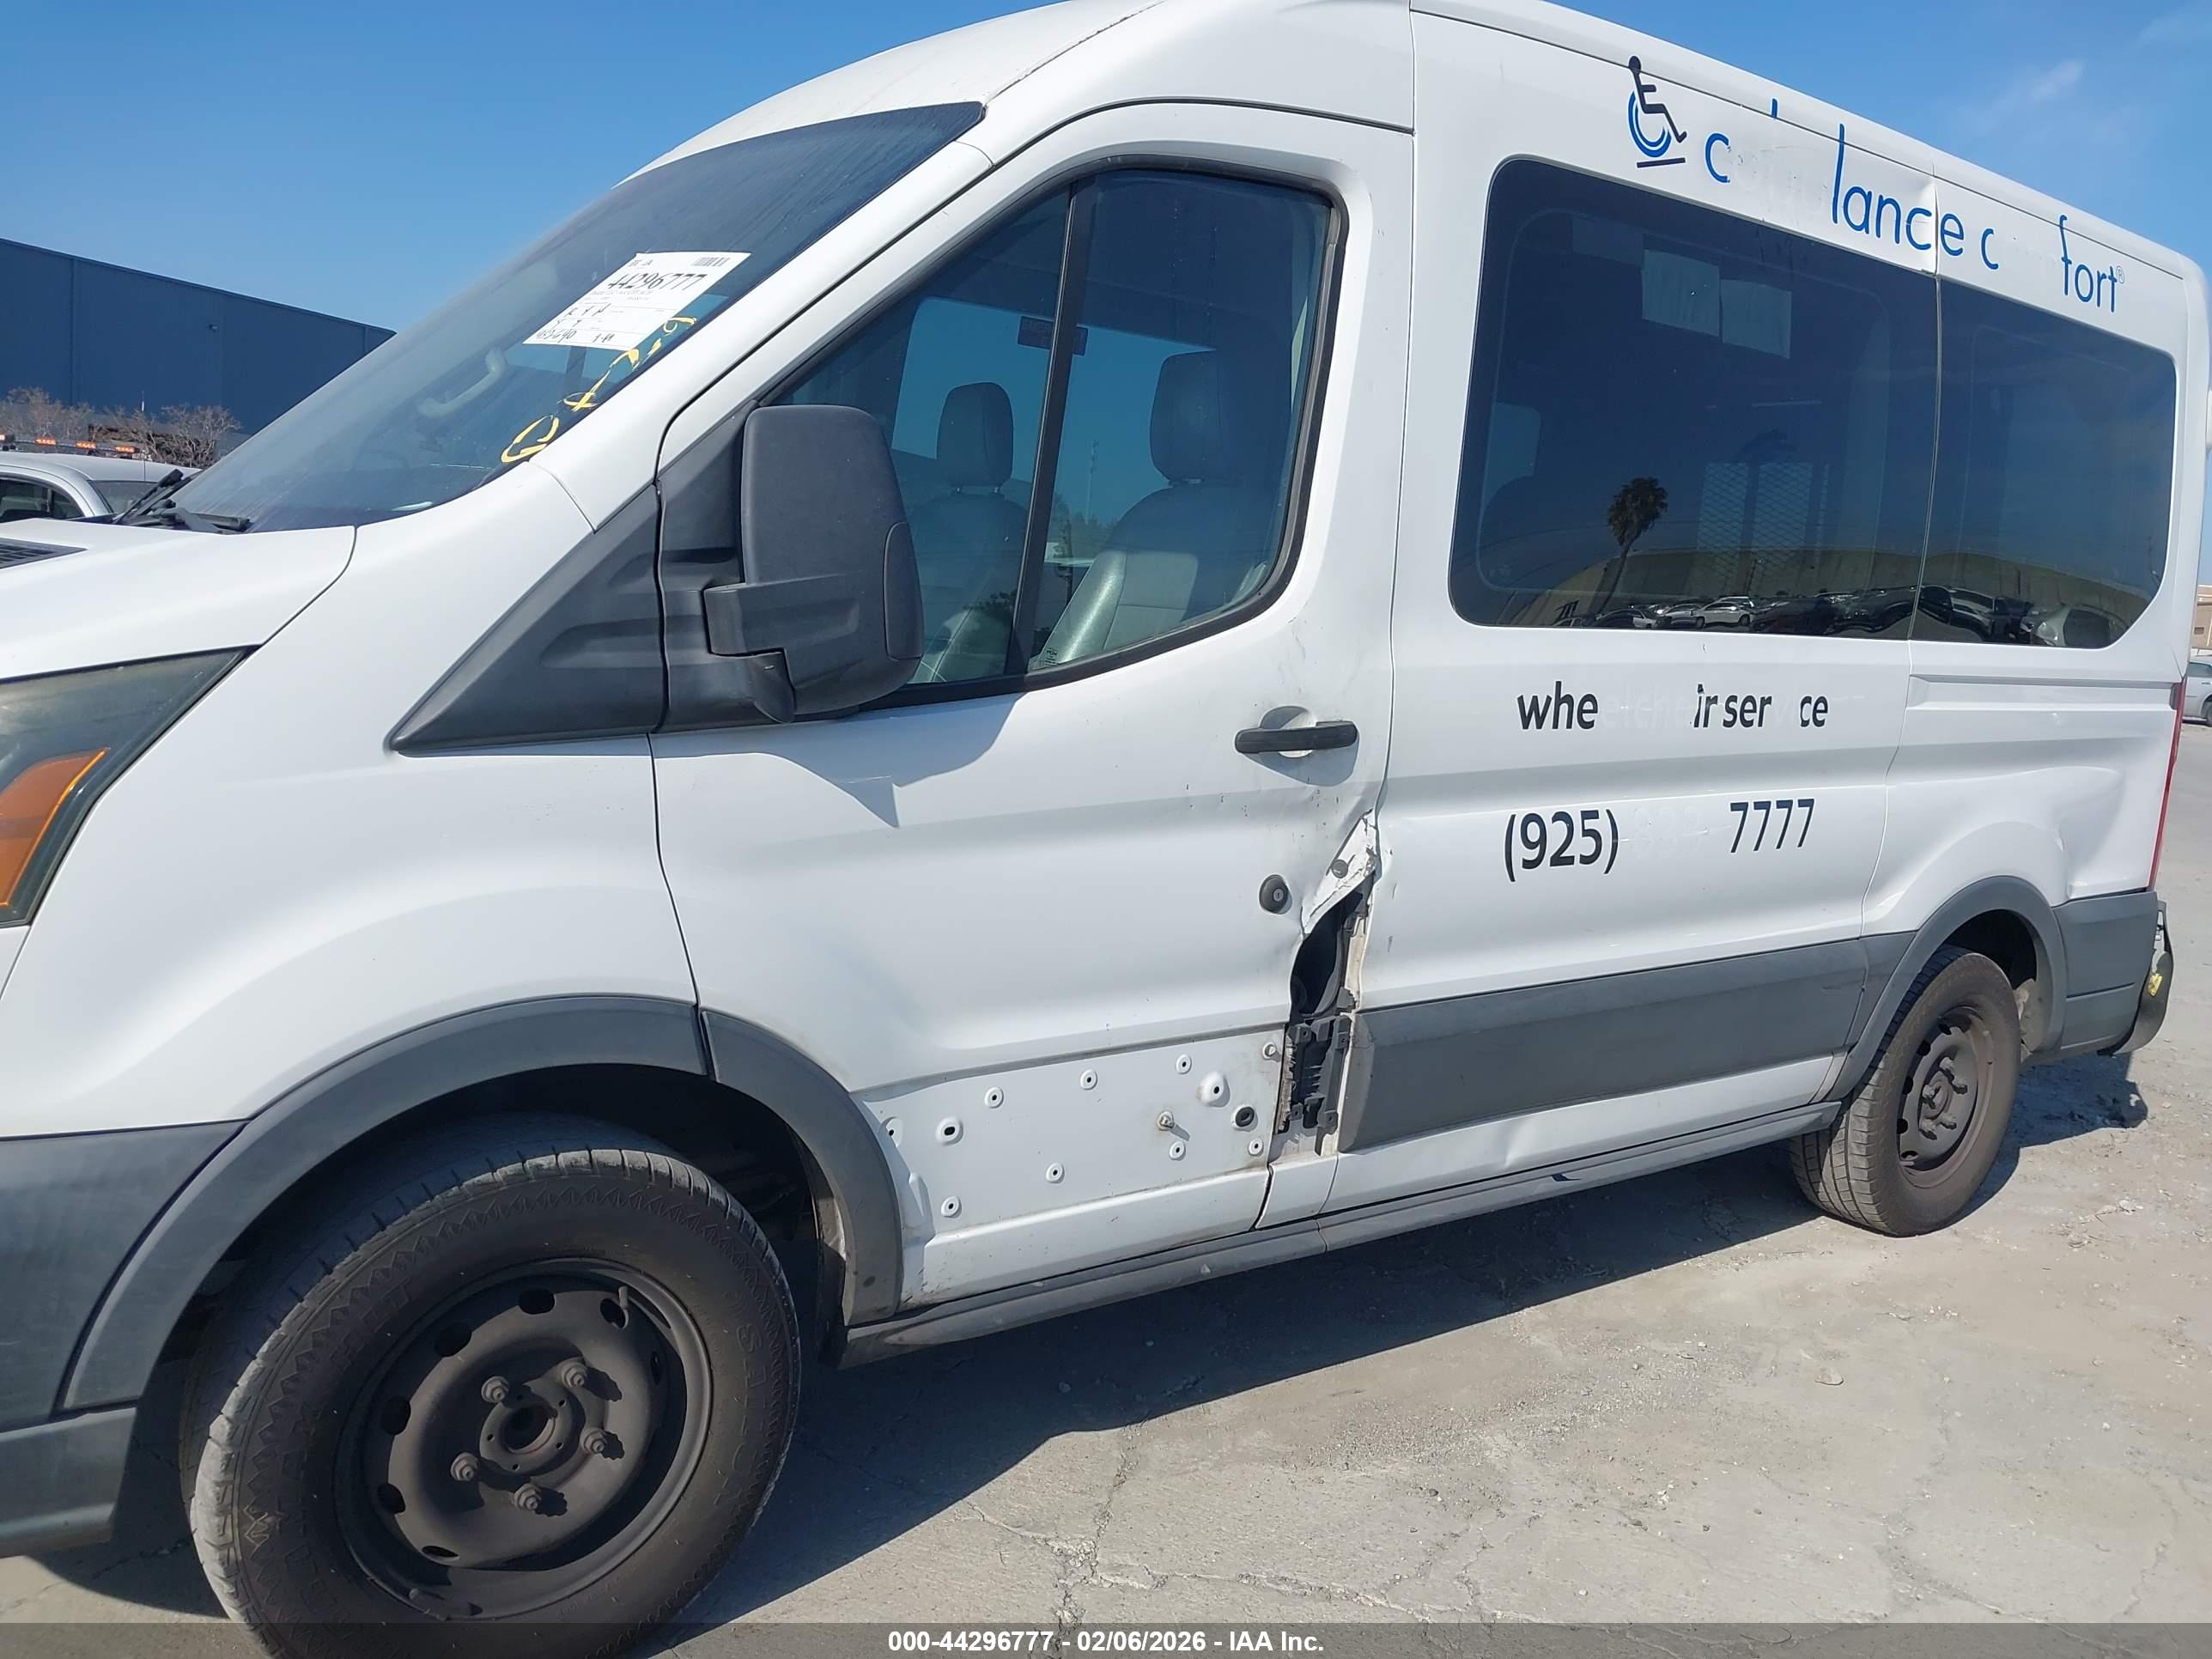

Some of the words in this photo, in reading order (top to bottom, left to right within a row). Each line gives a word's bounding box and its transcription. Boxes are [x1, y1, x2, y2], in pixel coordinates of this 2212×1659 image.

[607, 272, 708, 289] 44296777
[1504, 809, 1619, 883] (925)
[1729, 798, 1815, 854] 7777
